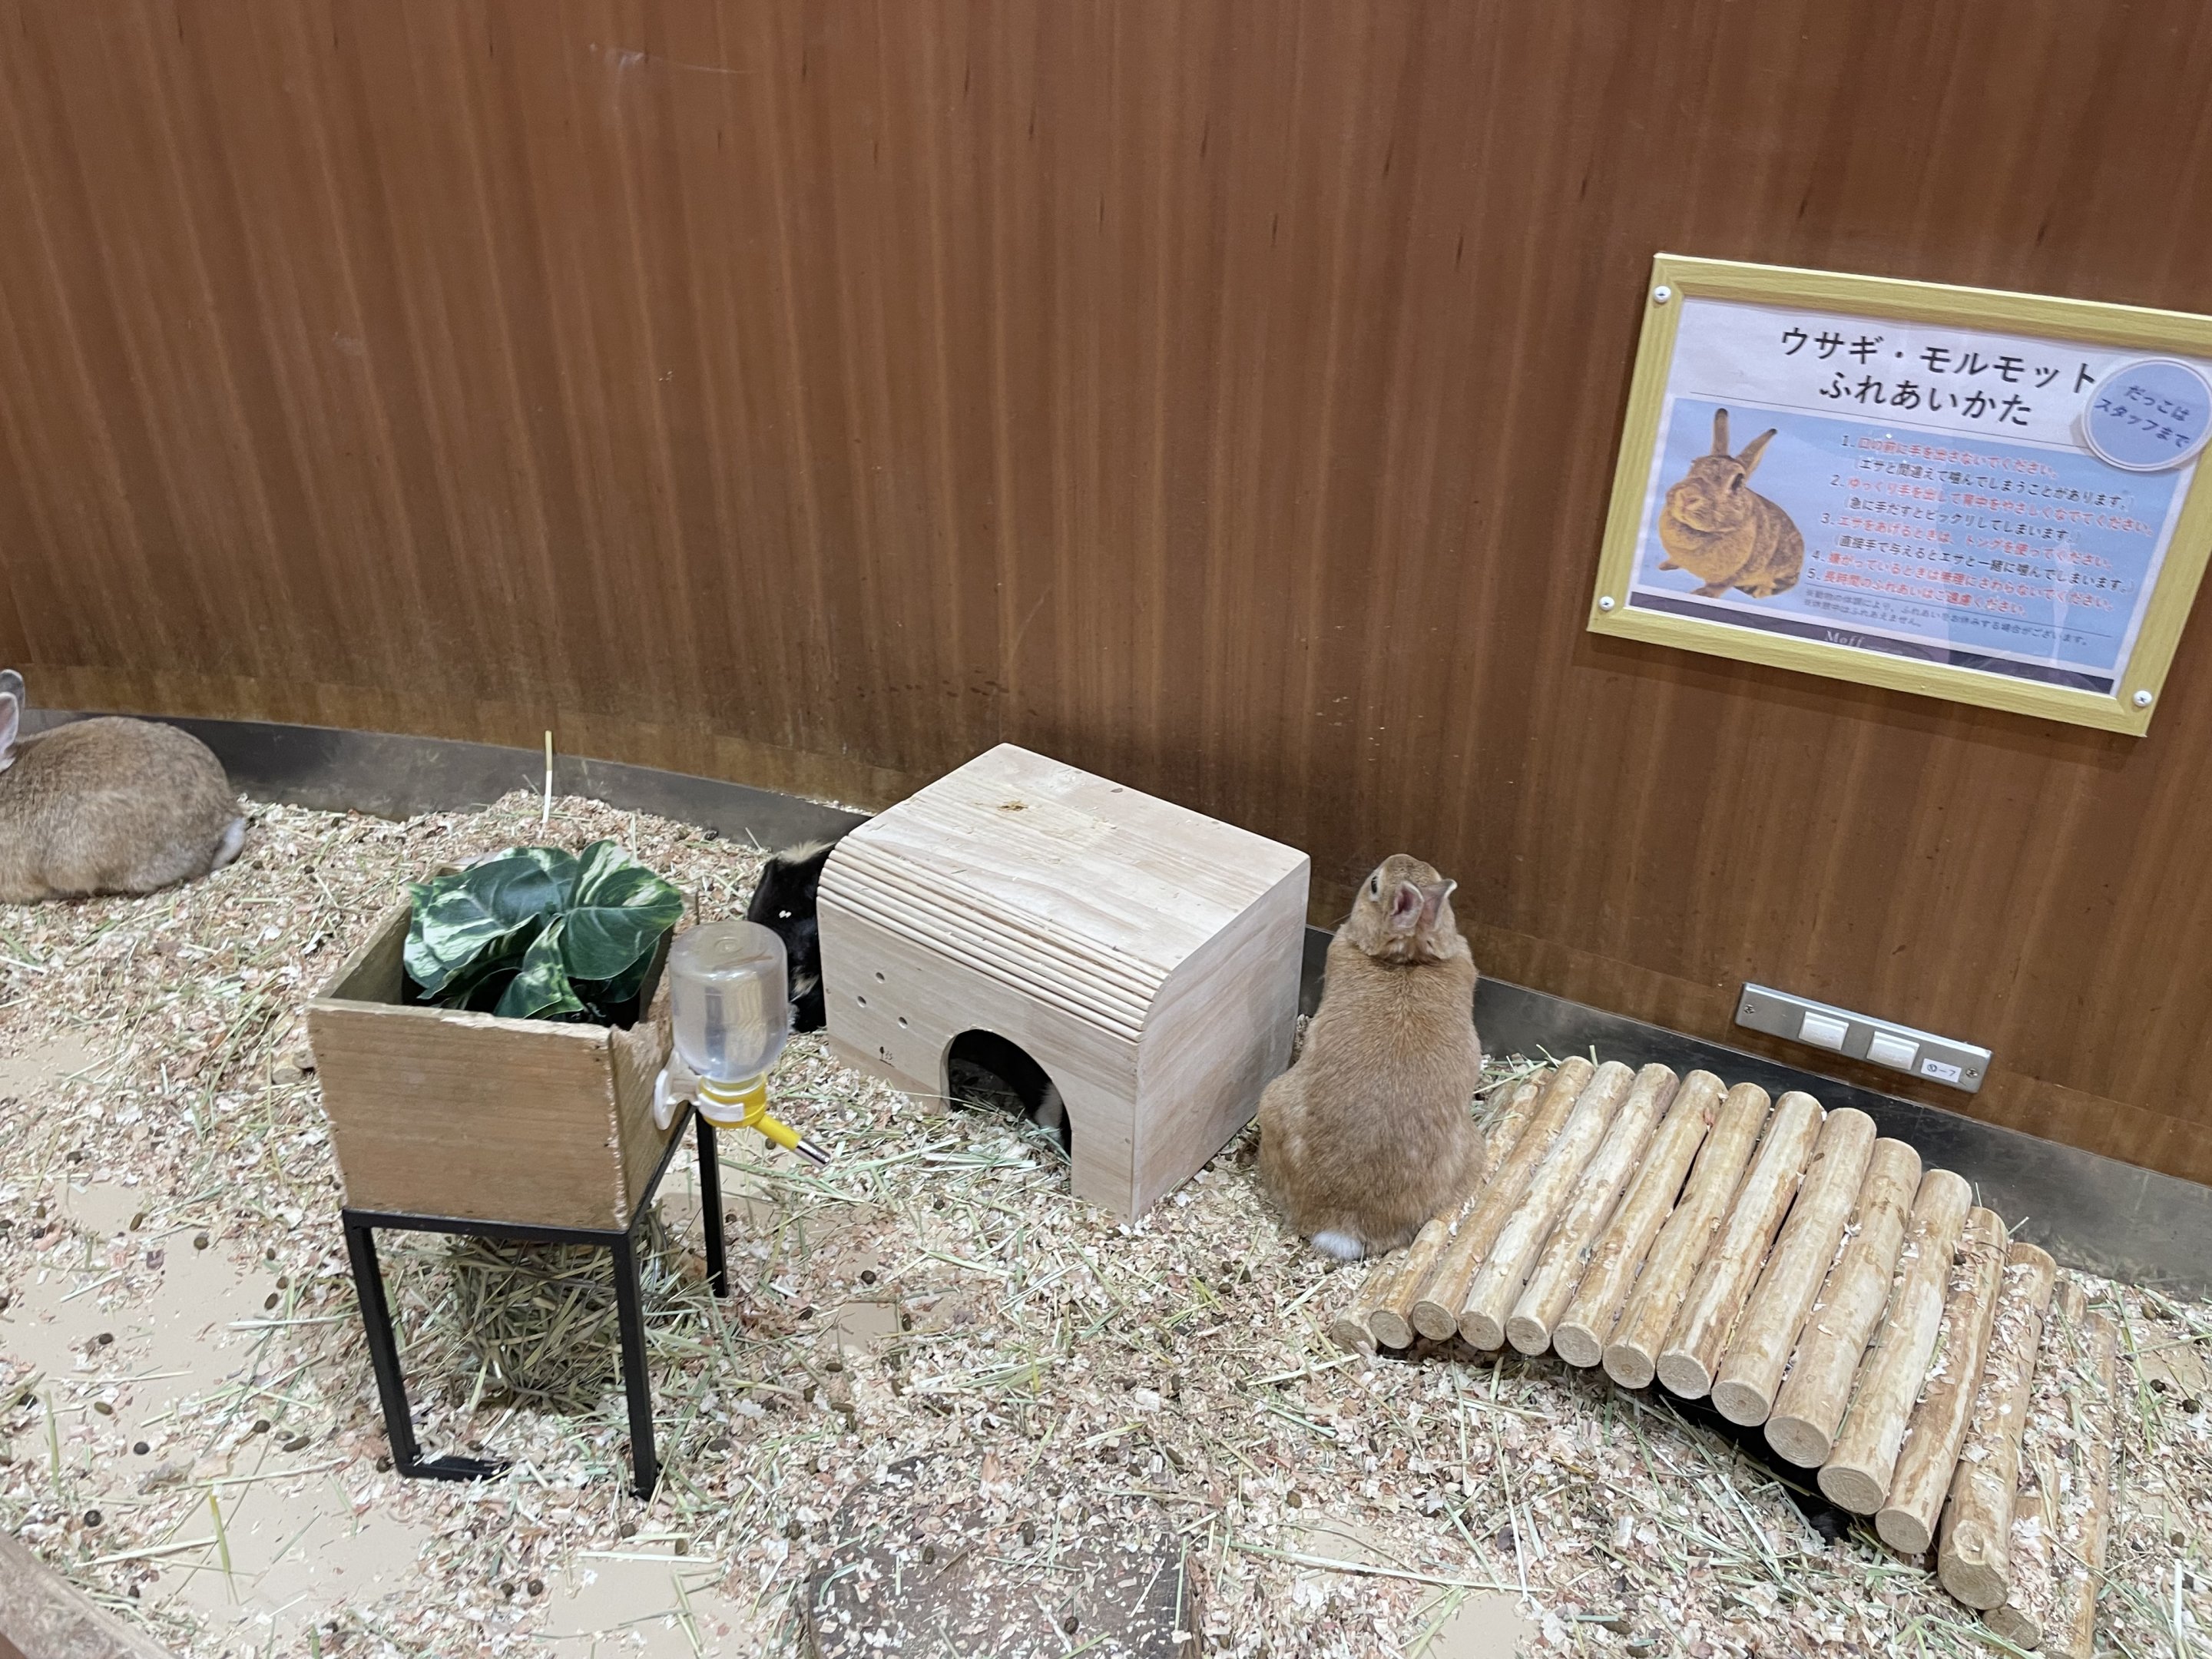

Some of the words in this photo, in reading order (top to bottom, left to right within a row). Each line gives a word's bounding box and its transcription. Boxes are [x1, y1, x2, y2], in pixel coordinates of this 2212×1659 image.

[1781, 327, 2096, 393] ウサギ・モルモット
[1820, 372, 2032, 426] ふれあいかた
[2094, 398, 2190, 448] スタッフまで
[2124, 386, 2190, 421] だっこは
[1825, 631, 1865, 647] Moff
